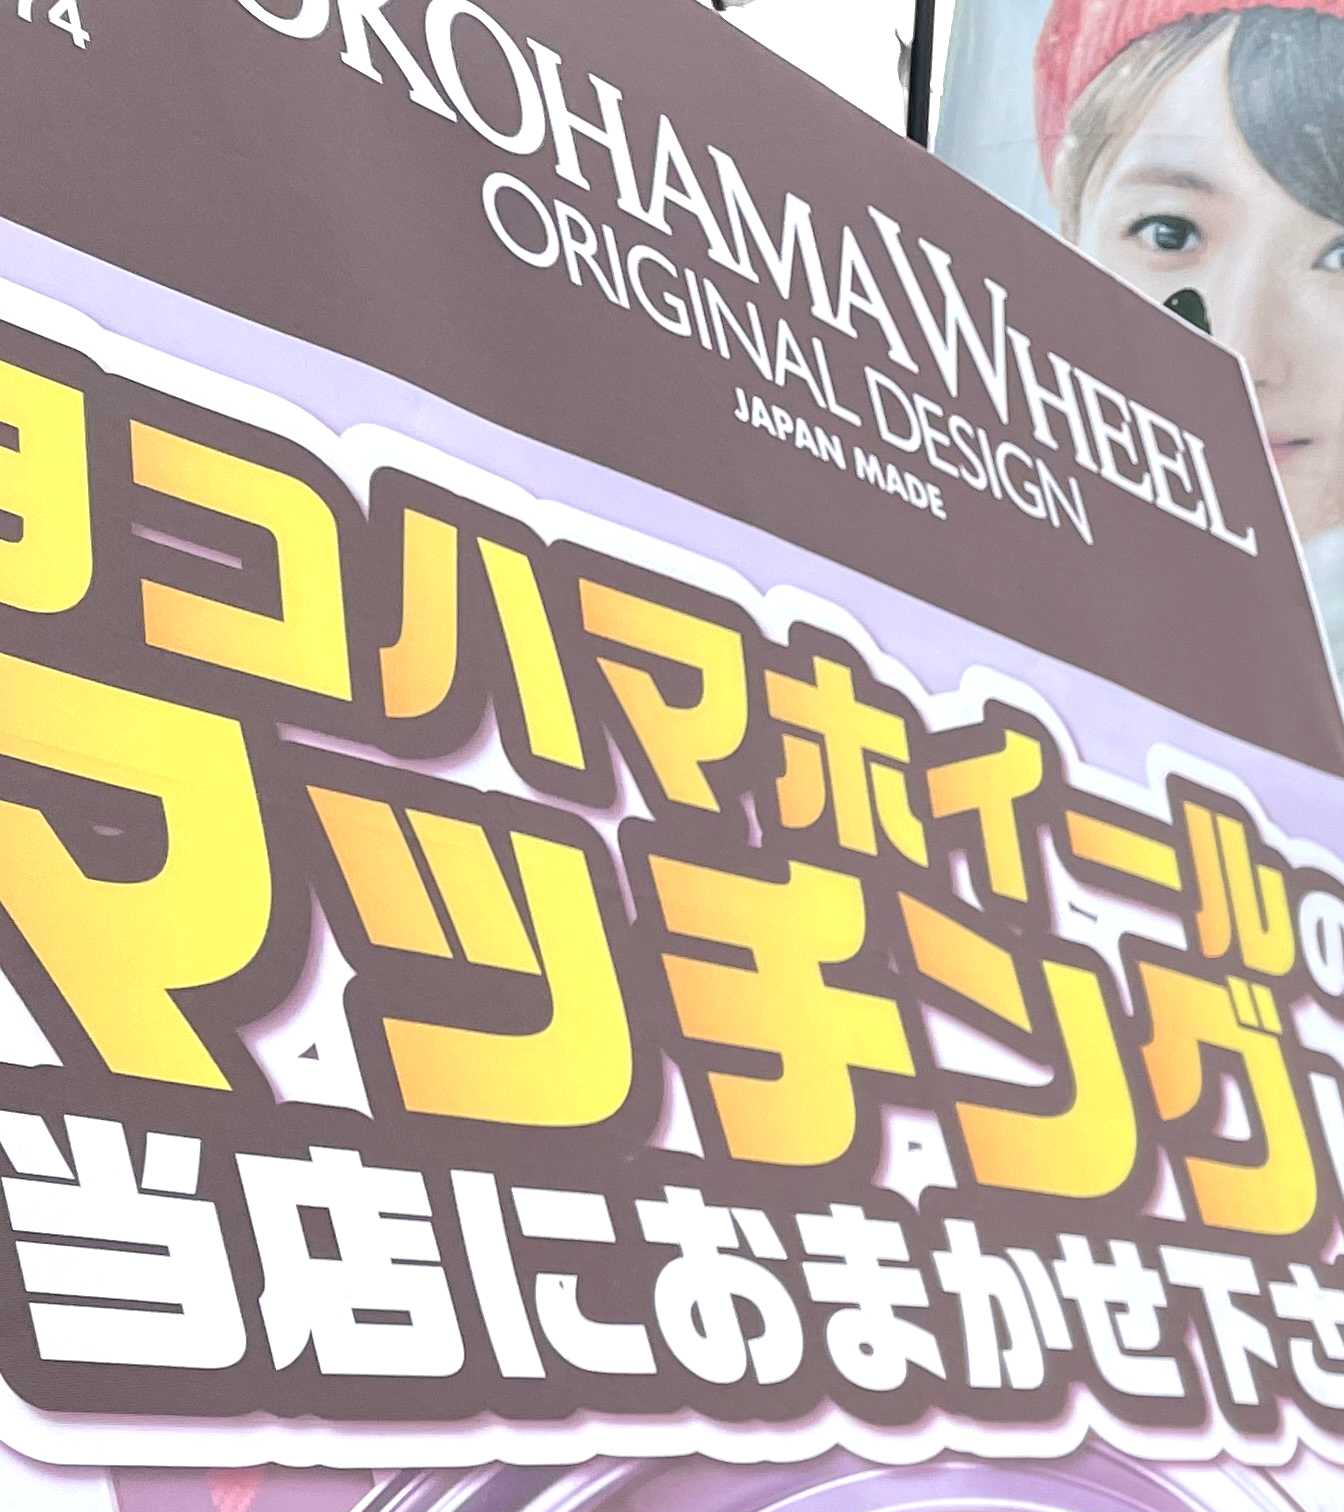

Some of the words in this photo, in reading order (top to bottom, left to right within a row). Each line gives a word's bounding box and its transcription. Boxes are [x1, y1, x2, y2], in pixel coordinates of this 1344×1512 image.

[481, 171, 862, 428] ORIGINAL
[866, 367, 1093, 546] DESIGN
[734, 388, 846, 472] JAPAN
[854, 455, 948, 522] MADE
